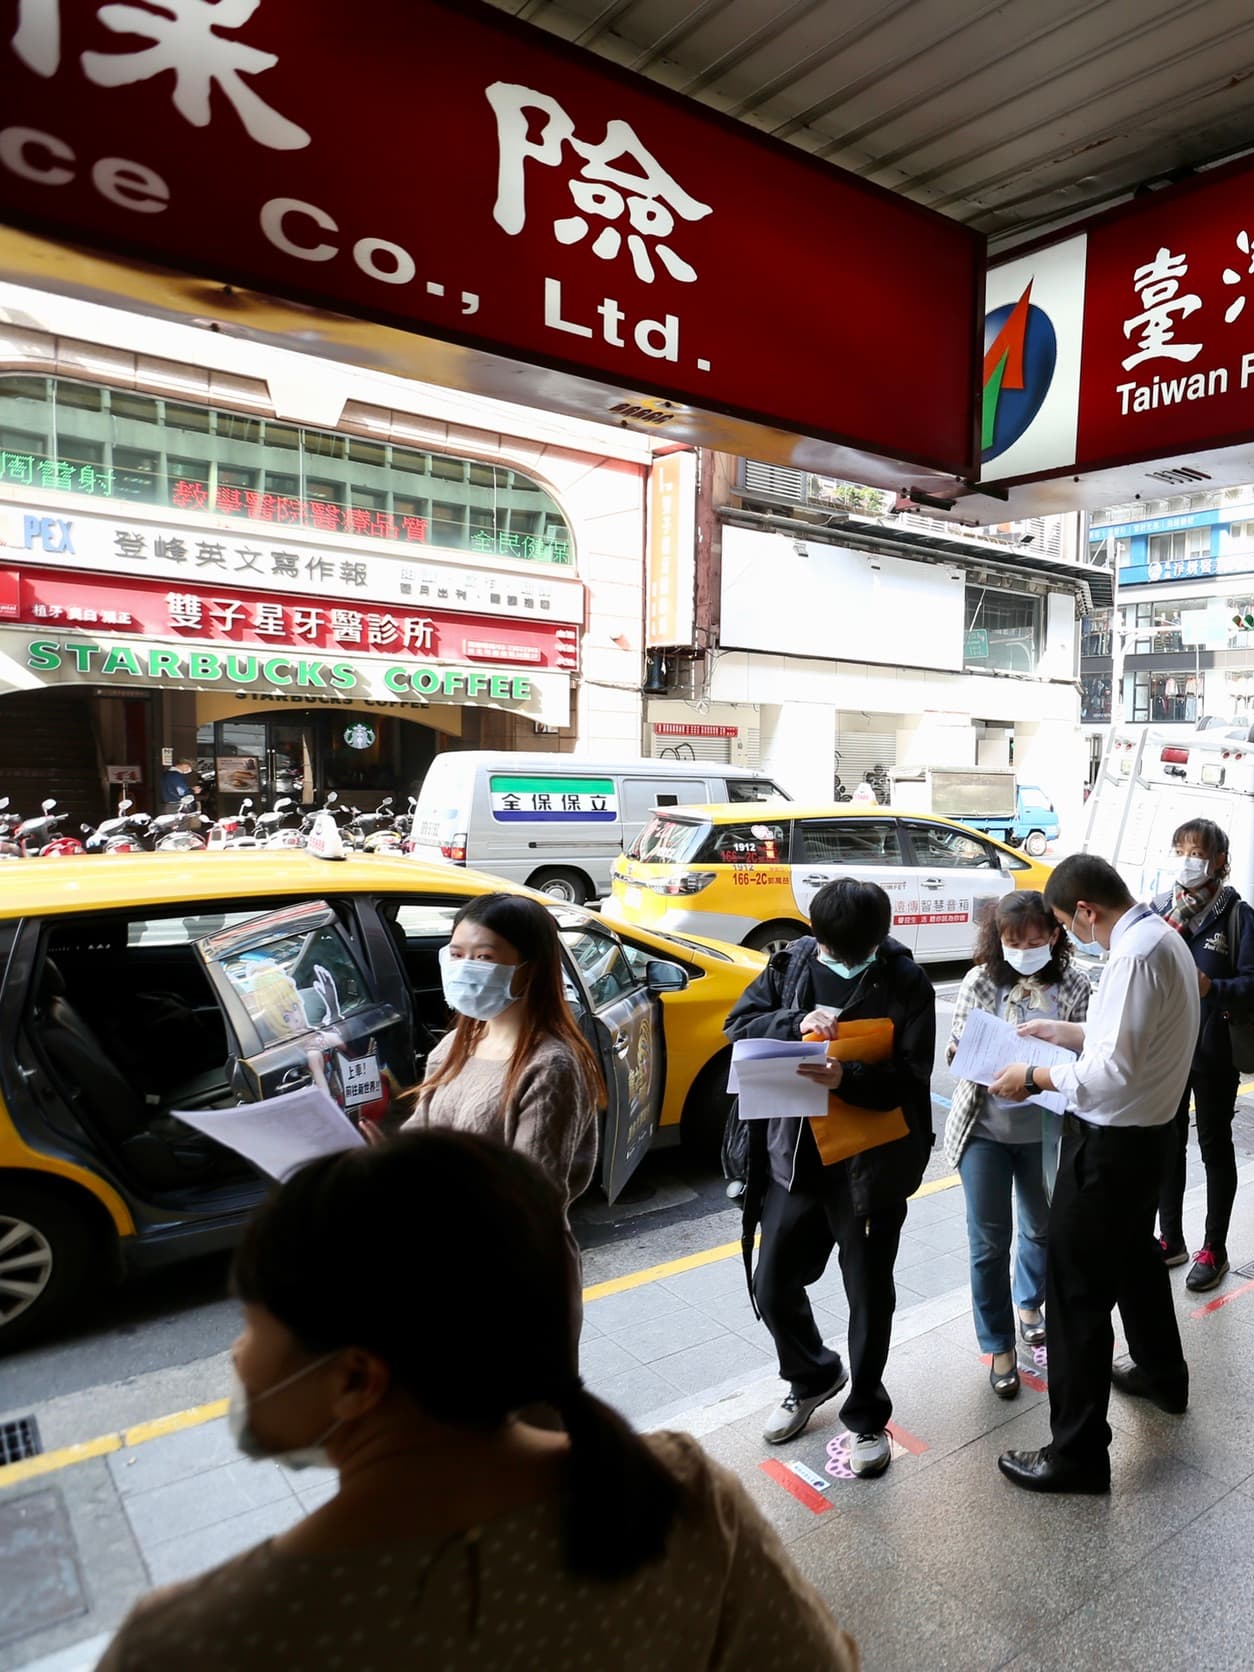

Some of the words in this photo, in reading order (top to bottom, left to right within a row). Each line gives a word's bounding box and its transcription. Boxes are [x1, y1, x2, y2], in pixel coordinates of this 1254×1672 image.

[260, 198, 480, 315] Co.,
[544, 277, 712, 372] Ltd.
[1116, 368, 1229, 416] Taiwan
[24, 515, 75, 555] PEX
[114, 530, 368, 588] 登峰英文寫作報
[470, 529, 570, 565] 全民健保
[165, 592, 433, 649] 雙子星牙醫診所
[27, 640, 357, 688] STARBUCKS
[383, 666, 531, 699] COFFEE
[734, 843, 756, 852] 1912
[733, 873, 767, 886] 166-2C
